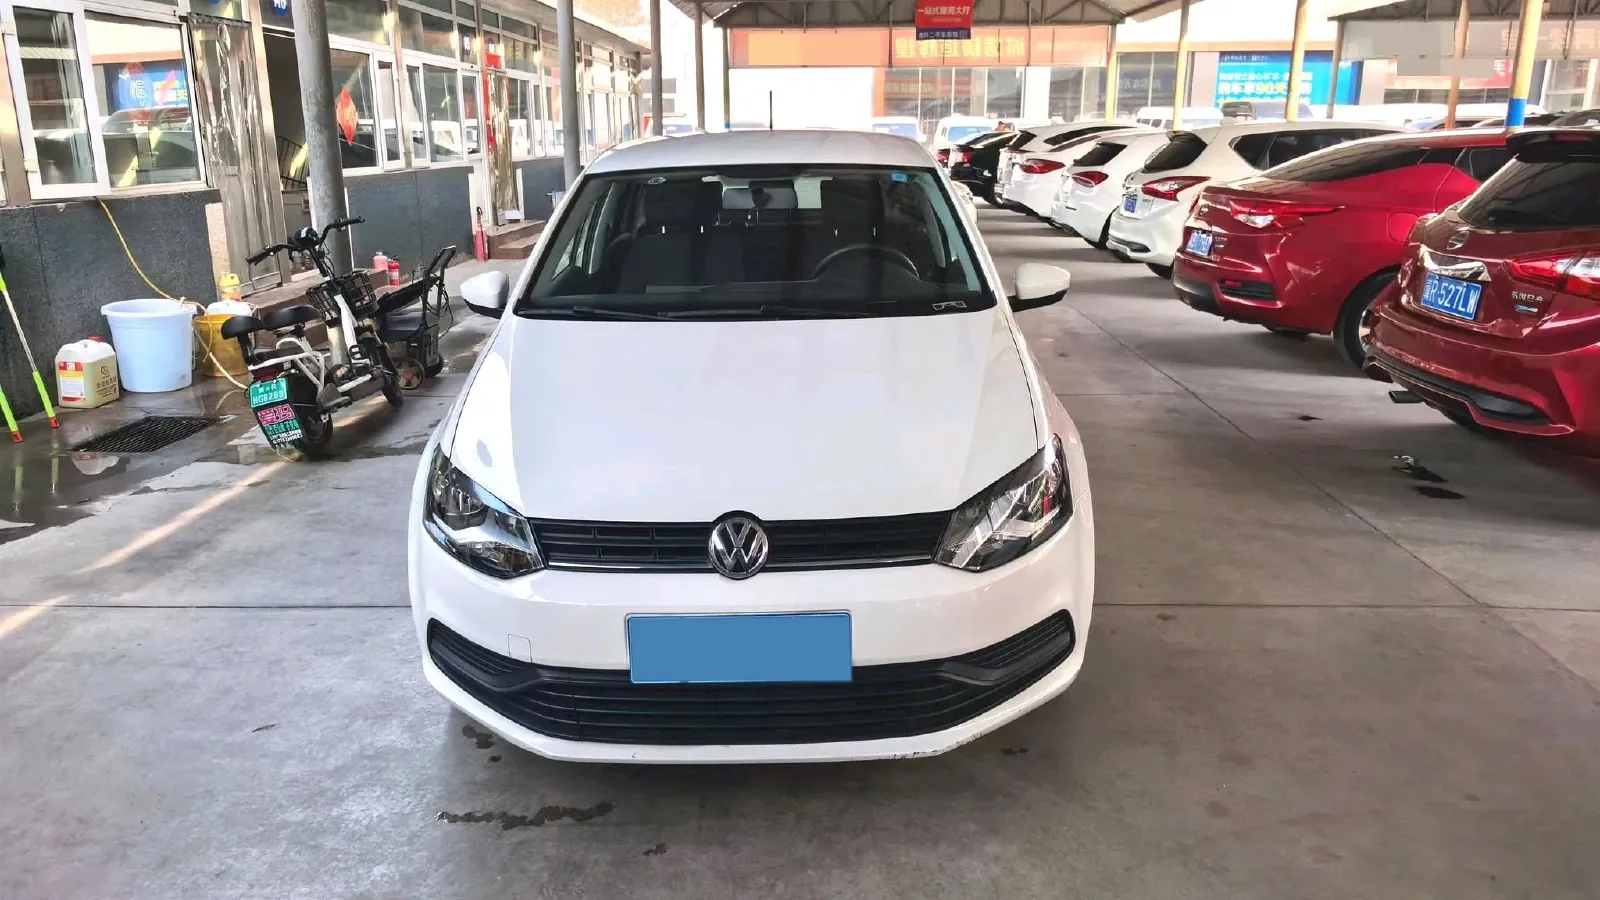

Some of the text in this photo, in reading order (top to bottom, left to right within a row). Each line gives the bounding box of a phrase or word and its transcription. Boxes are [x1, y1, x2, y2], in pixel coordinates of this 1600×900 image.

[917, 6, 971, 16] 一站式服务大厅
